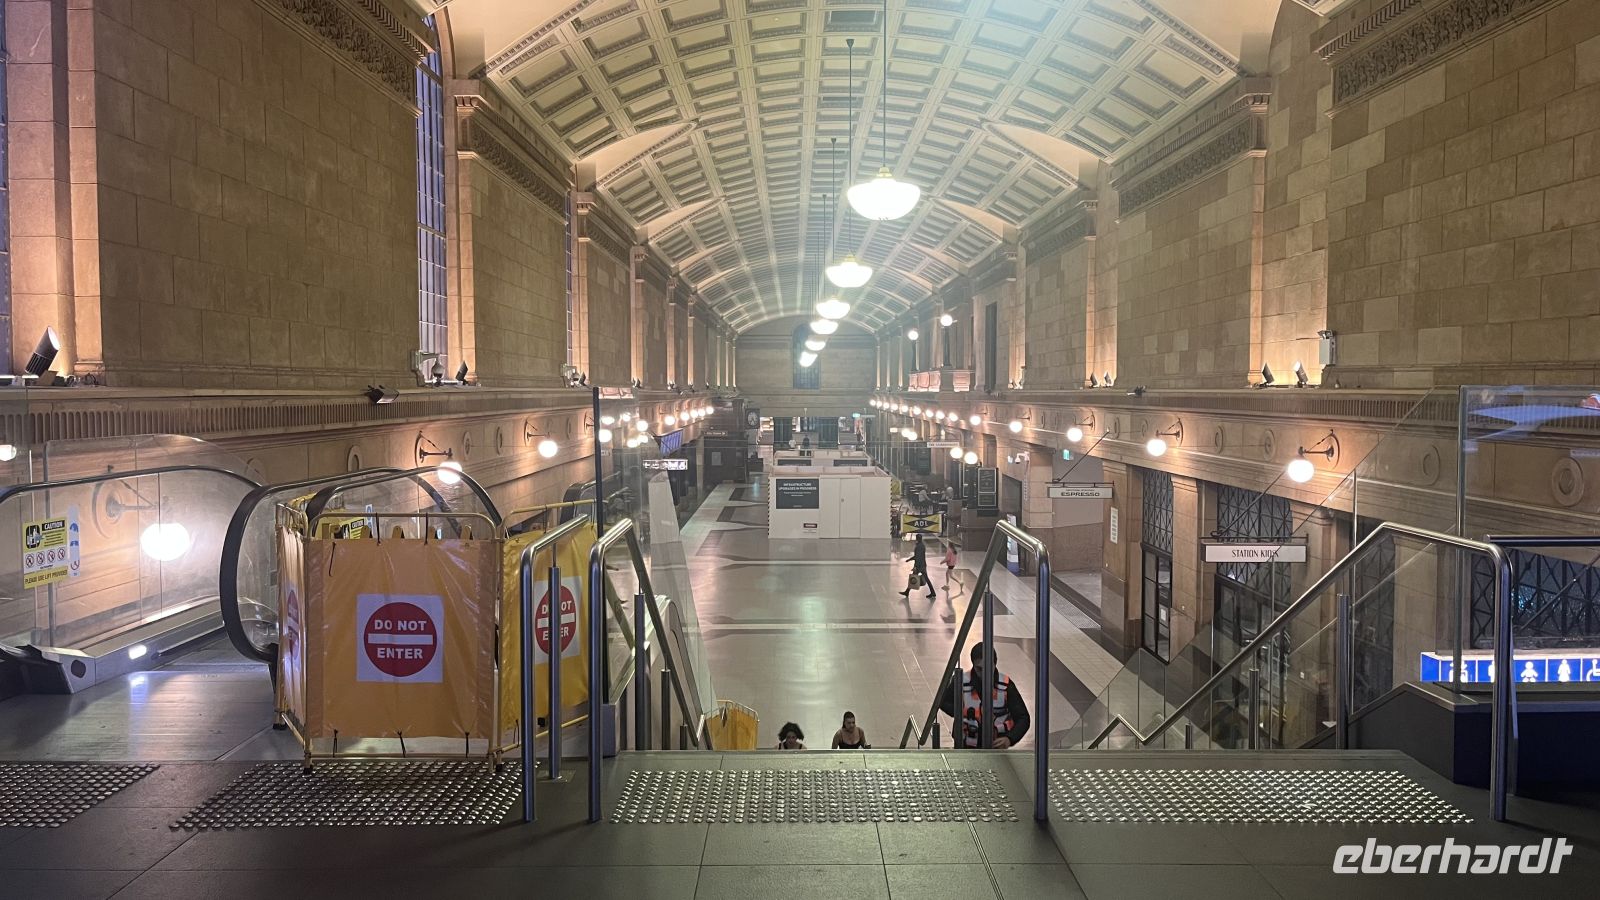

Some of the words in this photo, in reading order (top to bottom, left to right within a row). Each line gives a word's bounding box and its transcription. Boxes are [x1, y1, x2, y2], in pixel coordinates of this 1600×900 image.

[44, 521, 63, 530] CAUTION
[1232, 549, 1258, 558] STATION
[1260, 550, 1279, 558] KIOSK
[374, 620, 393, 630] DO
[398, 620, 427, 631] NOT
[377, 647, 423, 659] ENTER
